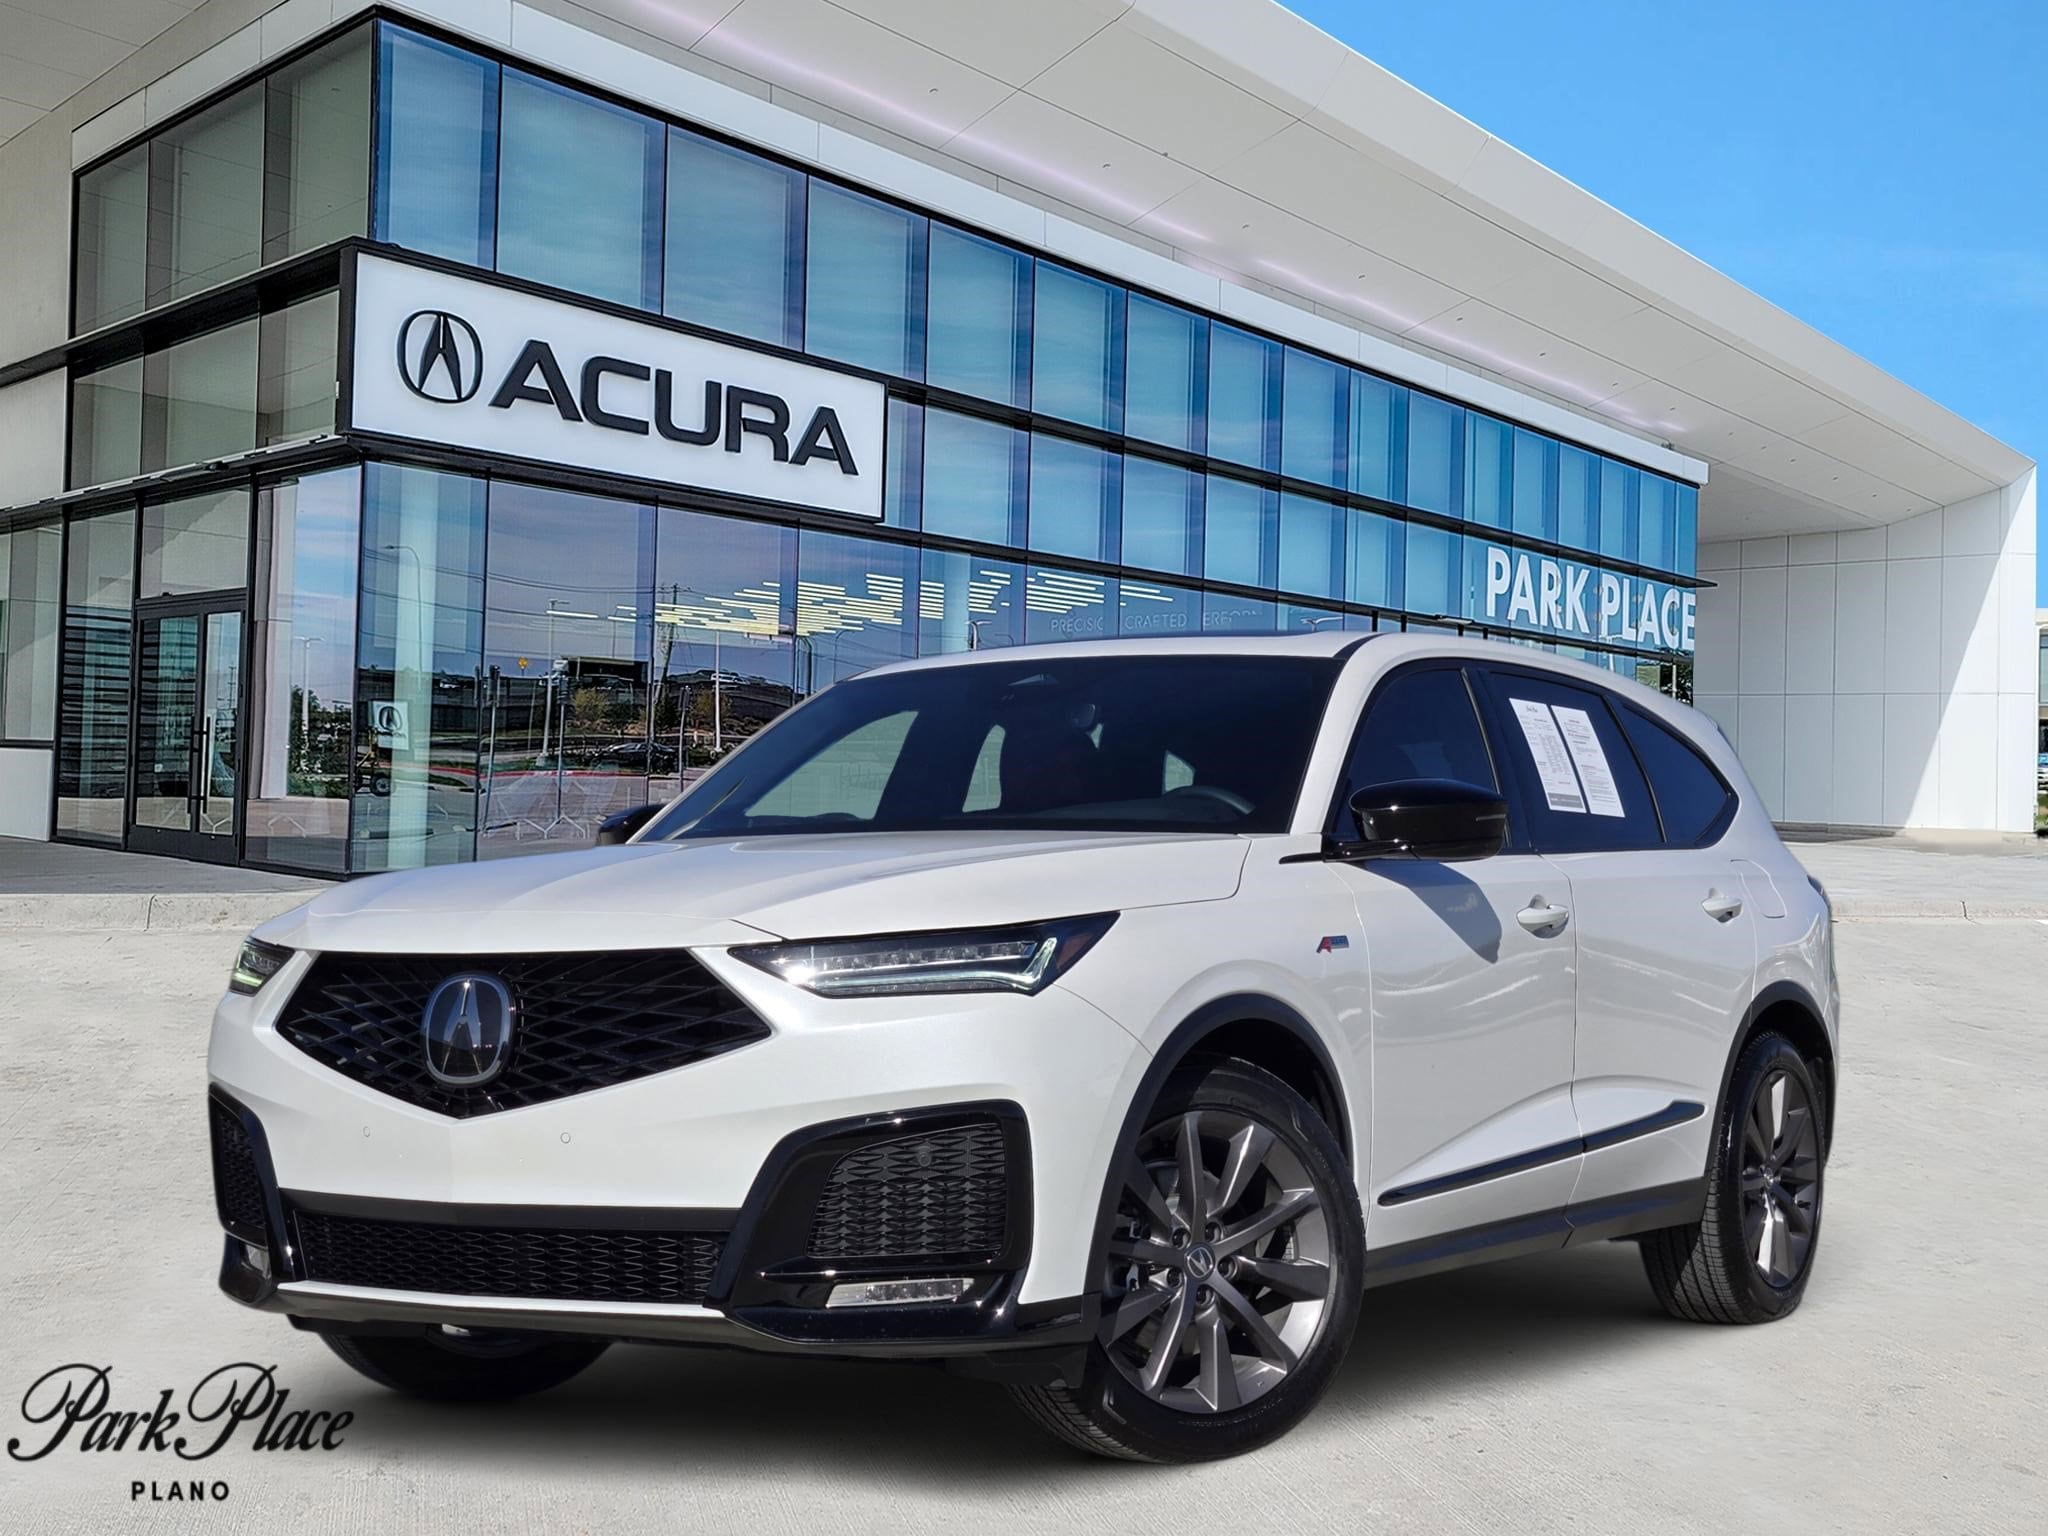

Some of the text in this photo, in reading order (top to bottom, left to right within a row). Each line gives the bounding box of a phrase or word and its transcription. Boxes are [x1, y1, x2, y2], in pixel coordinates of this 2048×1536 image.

[488, 339, 859, 476] ACURA
[1124, 613, 1188, 630] CRAFTED
[1487, 546, 1696, 650] PARK PLACE
